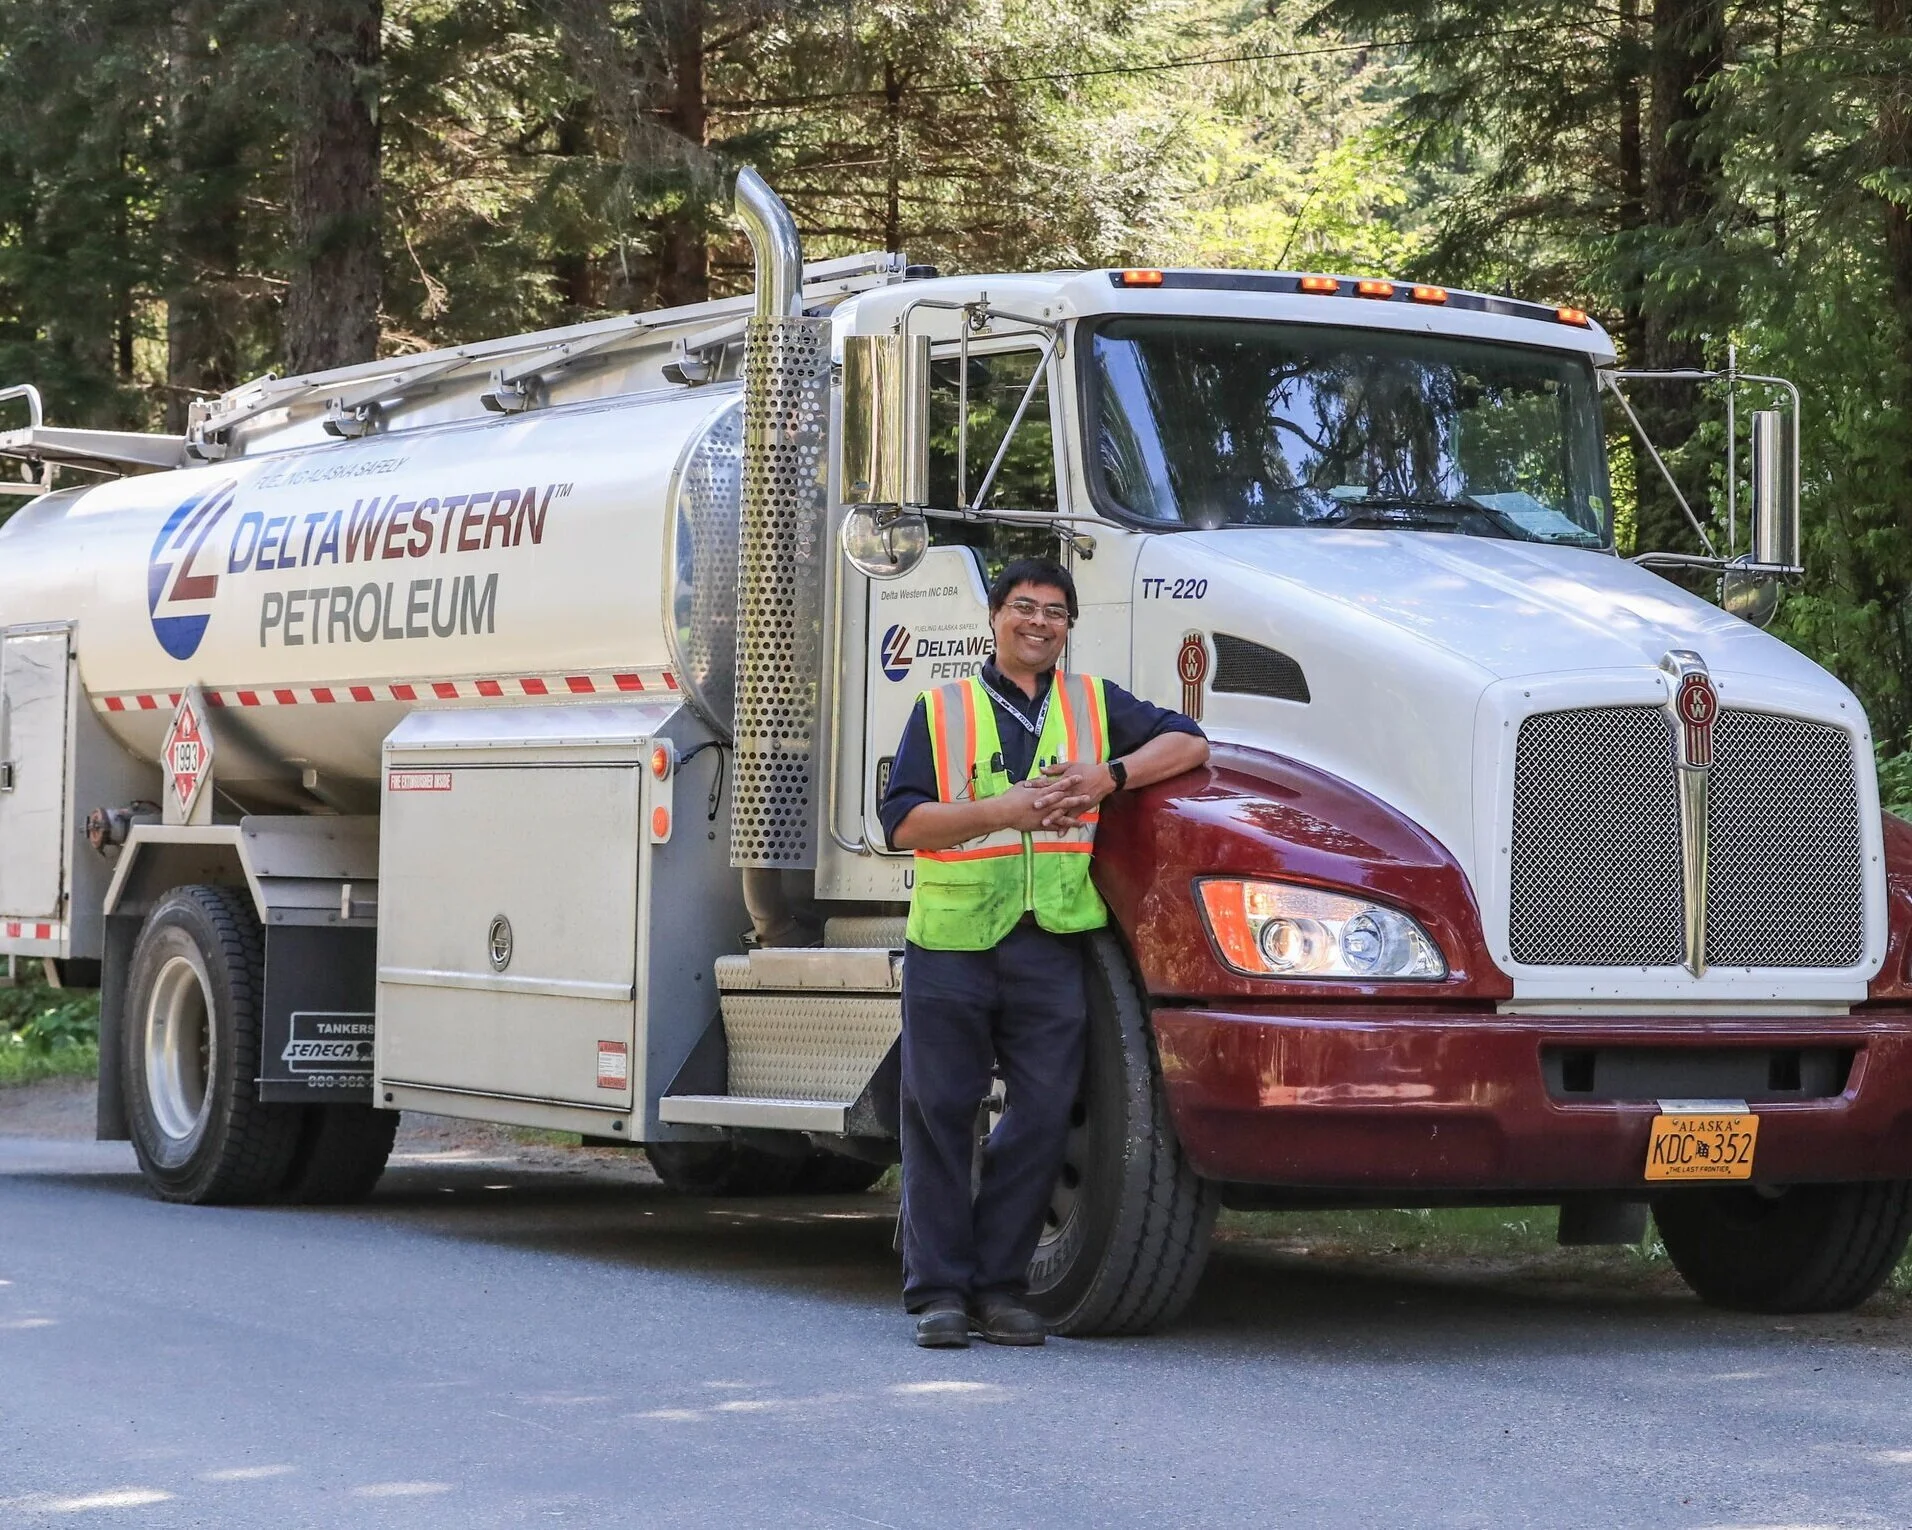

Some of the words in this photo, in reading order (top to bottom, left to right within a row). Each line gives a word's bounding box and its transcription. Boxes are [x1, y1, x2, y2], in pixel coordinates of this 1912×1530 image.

[307, 464, 354, 482] ALASKA
[355, 457, 411, 477] SAFELY
[881, 591, 898, 600] Delta
[900, 589, 927, 599] Western
[928, 587, 942, 597] INC
[942, 586, 958, 596] DBA
[1142, 578, 1208, 599] TT-220
[260, 573, 499, 648] PETROLEUM
[916, 636, 996, 658] DELTAWE
[176, 743, 198, 771] 1993
[316, 1023, 375, 1034] TANKERS
[287, 1043, 354, 1057] SENECA
[1679, 1120, 1733, 1132] ALASKA
[1653, 1133, 1695, 1164] KDC
[1710, 1133, 1752, 1164] 352
